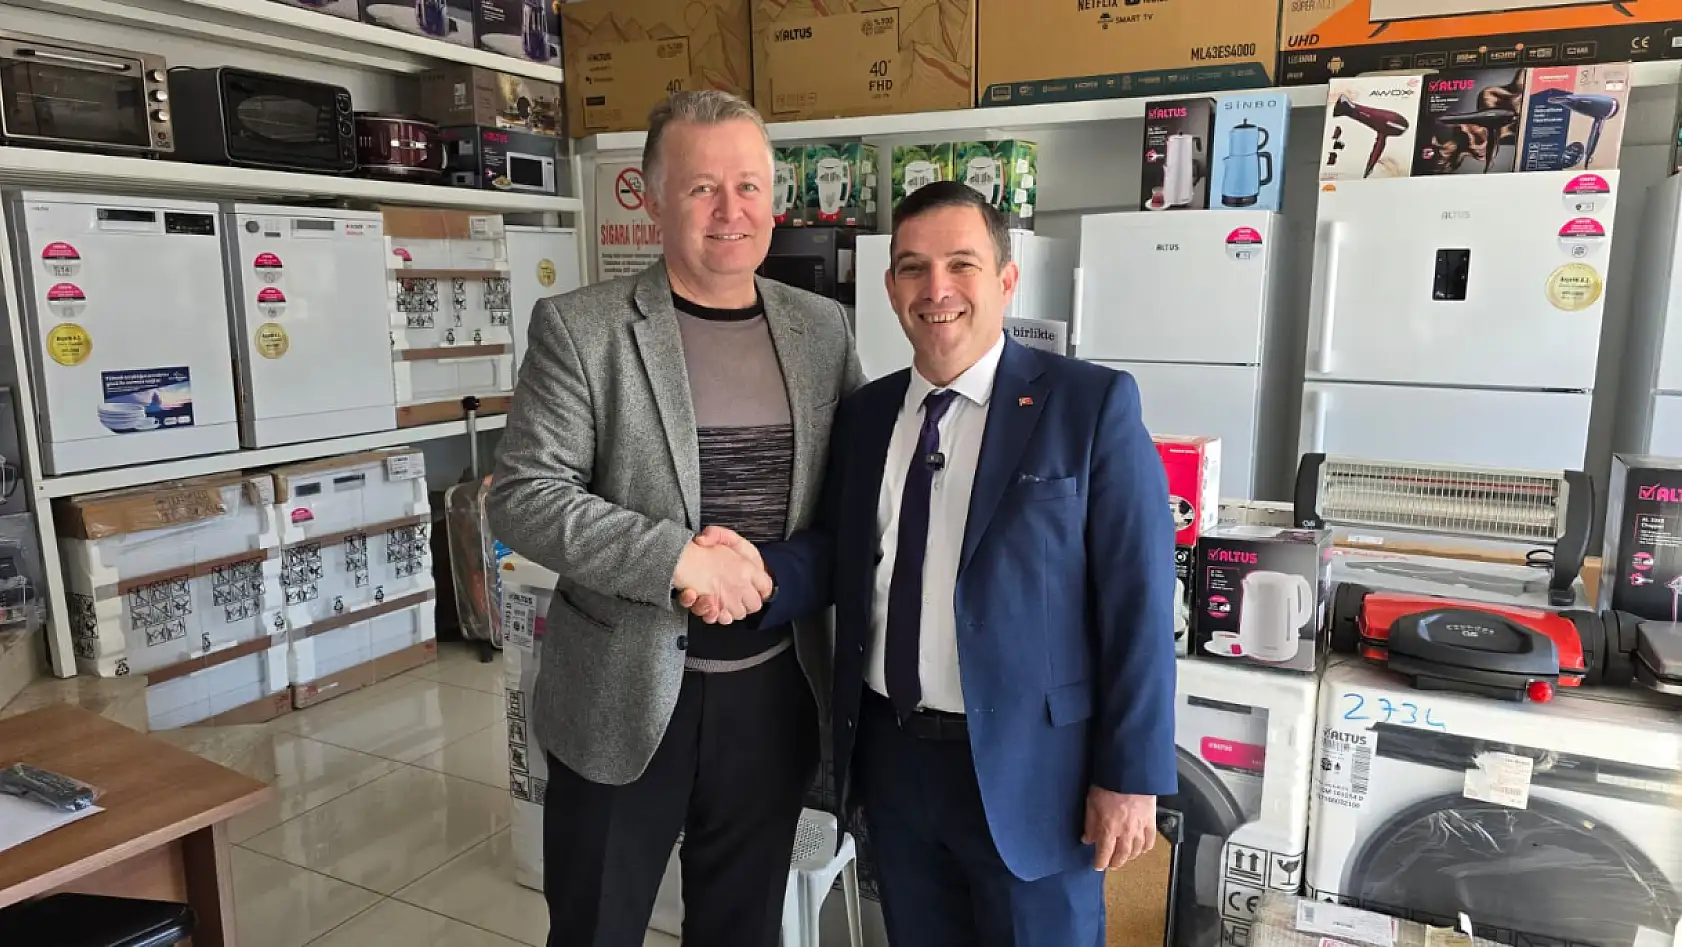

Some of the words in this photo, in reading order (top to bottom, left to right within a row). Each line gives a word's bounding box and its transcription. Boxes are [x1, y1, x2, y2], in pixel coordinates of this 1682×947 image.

[1115, 14, 1141, 24] SMART
[1143, 13, 1155, 21] TV
[782, 26, 812, 41] ALTUS
[1288, 34, 1320, 47] UHD
[1191, 43, 1256, 61] ML43ES4000
[868, 79, 894, 92] FHD
[1440, 79, 1475, 91] ALTUS
[1156, 107, 1188, 118] ALTUS
[600, 218, 631, 246] SİGARA
[1012, 325, 1055, 342] birlikte
[1219, 550, 1259, 564] ALTUS
[1330, 730, 1368, 746] ALTUS
[1228, 891, 1260, 915] CE
